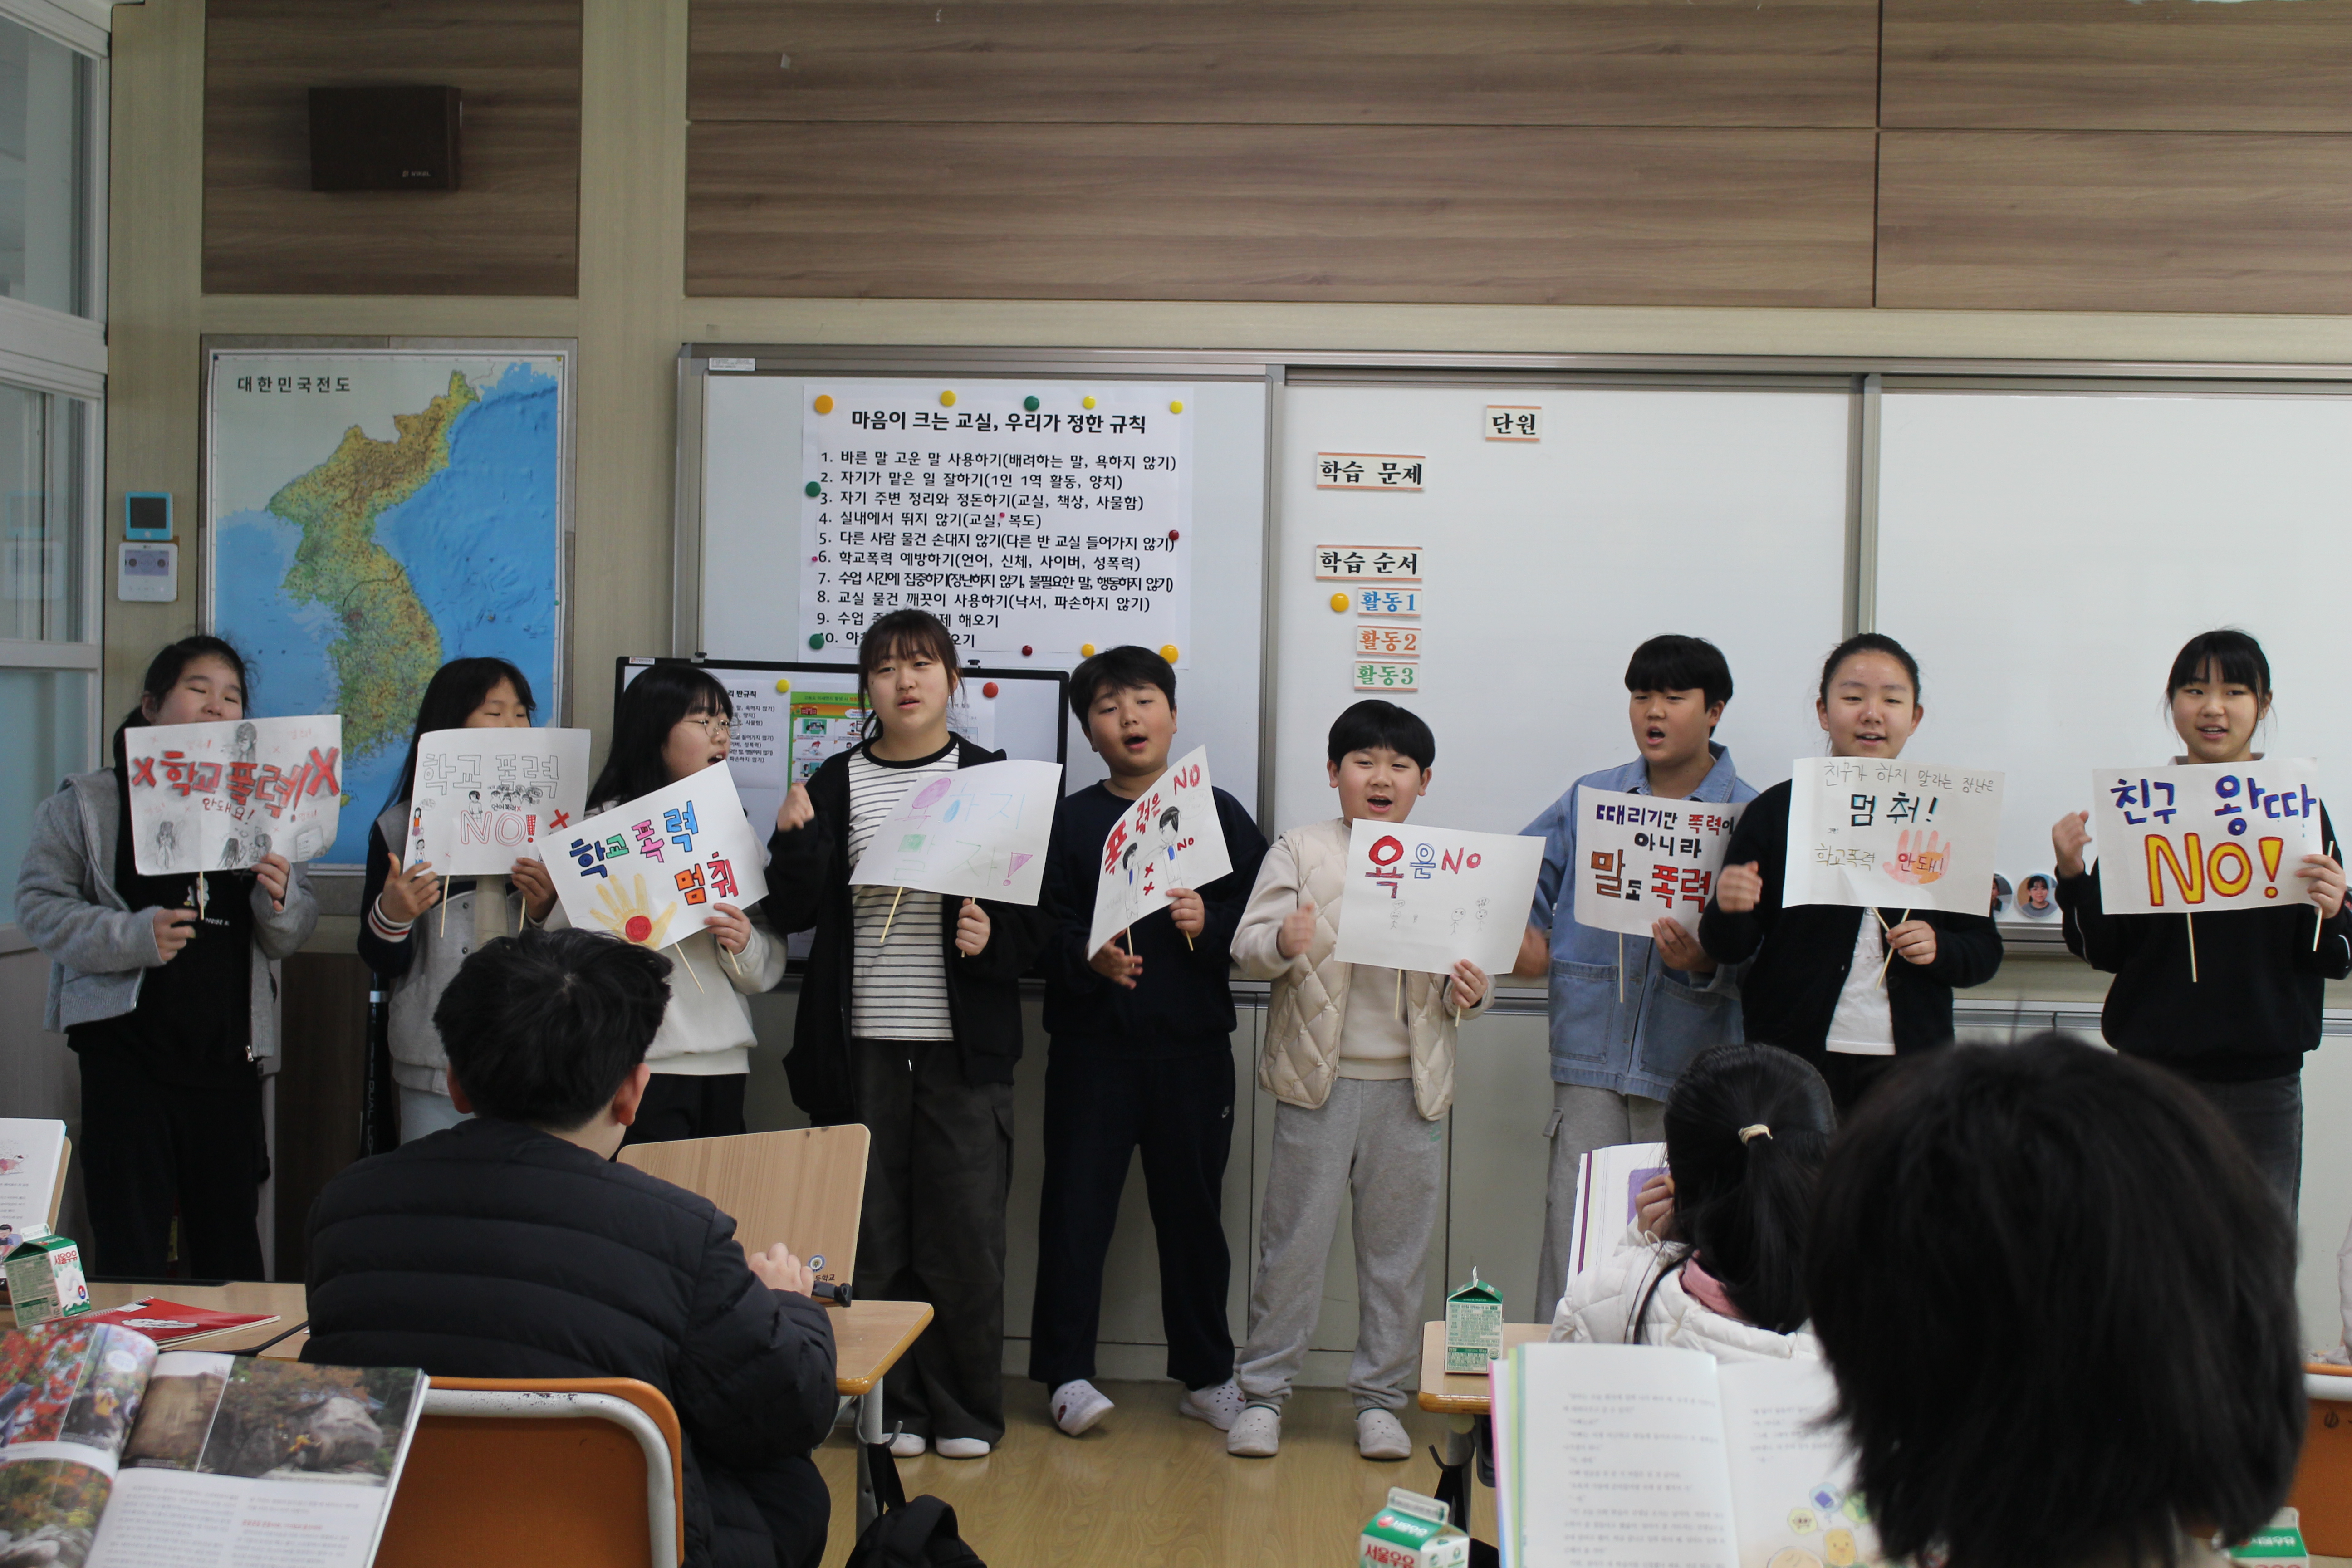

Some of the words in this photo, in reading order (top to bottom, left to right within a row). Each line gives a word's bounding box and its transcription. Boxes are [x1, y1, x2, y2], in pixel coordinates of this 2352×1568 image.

[237, 376, 350, 393] 대한민국전도
[852, 411, 906, 430] 마음이
[912, 412, 950, 431] 크는
[956, 413, 998, 432] 교실,
[1005, 413, 1061, 433] 우리가
[1067, 414, 1104, 434] 정한
[1110, 415, 1146, 435] 규칙
[1492, 413, 1536, 436] 단원
[821, 452, 833, 462] 1.
[841, 451, 868, 465] 바른
[875, 451, 888, 466] 말
[894, 451, 921, 466] 고운
[928, 453, 941, 466] 말
[947, 453, 1063, 469] 사용하기(배려하는
[1070, 455, 1088, 469] 말,
[1095, 455, 1135, 470] 욕하지
[1143, 456, 1176, 471] 않기)
[1319, 460, 1365, 483] 학습
[1377, 462, 1422, 485] 문제
[820, 473, 833, 482] 2.
[841, 471, 882, 485] 자기가
[888, 472, 915, 486] 맡은
[923, 473, 935, 487] 일
[943, 473, 1012, 489] 잘하기(1인
[1021, 474, 1042, 488] 1역
[1050, 475, 1081, 489] 활동,
[1089, 475, 1122, 490] 양치)
[820, 492, 833, 505] 3.
[840, 491, 866, 505] 자기
[874, 492, 900, 506] 주변
[909, 492, 949, 507] 정리와
[957, 494, 1049, 509] 정돈하기(교실,
[1057, 495, 1088, 510] 책상,
[1096, 496, 1143, 511] 사물함)
[819, 512, 832, 524] 4.
[840, 511, 893, 526] 실내에서
[901, 512, 927, 526] 뛰지
[935, 513, 1001, 528] 않기(교실,
[1009, 514, 1042, 529] 복도)
[819, 533, 832, 545] 5.
[840, 532, 865, 545] 다른
[870, 532, 896, 546] 사람
[901, 533, 926, 546] 물건
[931, 533, 970, 547] 손대지
[975, 534, 1032, 549] 않기(다른
[1037, 535, 1050, 549] 반
[1055, 535, 1080, 550] 교실
[1086, 536, 1137, 551] 들어가지
[1143, 537, 1175, 552] 않기)
[818, 550, 831, 563] 6.
[839, 551, 892, 566] 학교폭력
[900, 553, 993, 568] 예방하기(언어,
[1001, 555, 1032, 568] 신체,
[1040, 556, 1085, 570] 사이버,
[1093, 557, 1140, 572] 성폭력)
[1319, 551, 1366, 574] 학습
[1372, 553, 1418, 575] 순서
[818, 573, 830, 585] 7.
[838, 572, 862, 585] 수업
[866, 572, 900, 586] 시간에
[904, 573, 995, 588] 집중하기(장난하지
[999, 574, 1025, 589] 않기,
[1029, 575, 1075, 590] 불필요한
[1078, 576, 1093, 590] 말,
[1097, 576, 1142, 591] 행동하지
[1146, 578, 1173, 593] 않기)
[817, 590, 830, 603] 8.
[838, 592, 864, 606] 교실
[872, 592, 898, 606] 물건
[906, 593, 946, 607] 깨끗이
[954, 594, 1047, 610] 사용하기(낙서,
[1054, 596, 1108, 610] 파손하지
[1117, 597, 1150, 612] 않기)
[1361, 591, 1416, 612] 활동1
[817, 612, 830, 625] 9.
[838, 612, 863, 626] 수업
[958, 614, 999, 628] 해오기
[820, 633, 838, 643] 0.
[1360, 630, 1416, 652] 활동2
[1357, 665, 1414, 686] 활동3
[423, 753, 482, 796] 학교
[495, 754, 559, 799] 폭력
[1824, 761, 1867, 786] 친구가
[1876, 763, 1907, 784] 하지
[1919, 770, 1952, 790] 말라는
[894, 777, 1025, 829] 욕하지
[1851, 791, 1939, 827] 멈춰!
[2111, 778, 2177, 825] 친구
[2214, 775, 2317, 836] 왕따
[461, 810, 537, 847] NO!
[1596, 804, 1678, 830] 때리기만
[1688, 813, 1734, 836] 폭력이
[1634, 832, 1701, 858] 아니라
[1815, 843, 1875, 871] 학교폭력
[674, 851, 739, 906] 멈춰
[1591, 849, 1642, 902] 말도
[1651, 864, 1712, 913] 폭력
[2144, 832, 2284, 907] NO!
